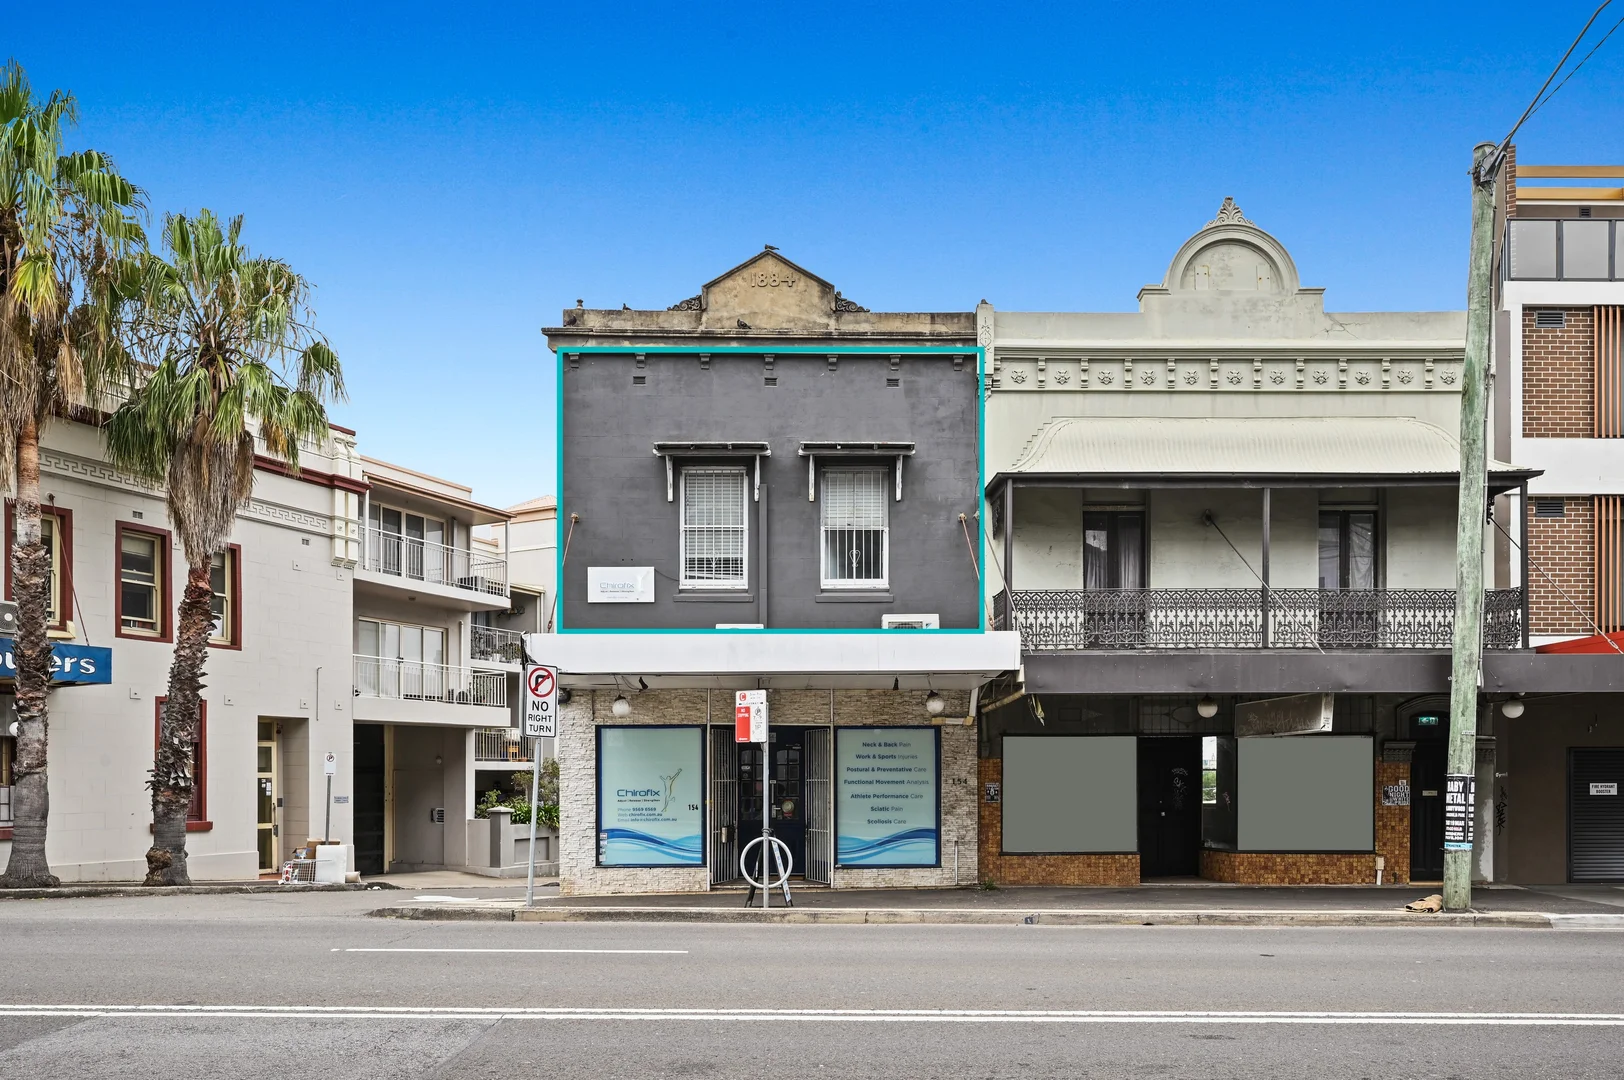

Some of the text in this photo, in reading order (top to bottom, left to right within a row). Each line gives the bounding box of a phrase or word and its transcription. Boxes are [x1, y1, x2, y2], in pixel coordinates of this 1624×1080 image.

[750, 271, 796, 288] 1884
[0, 650, 96, 674] uers
[532, 700, 549, 712] NO
[528, 714, 553, 722] RIGHT
[529, 724, 552, 733] TURN
[616, 789, 660, 797] Chirofix
